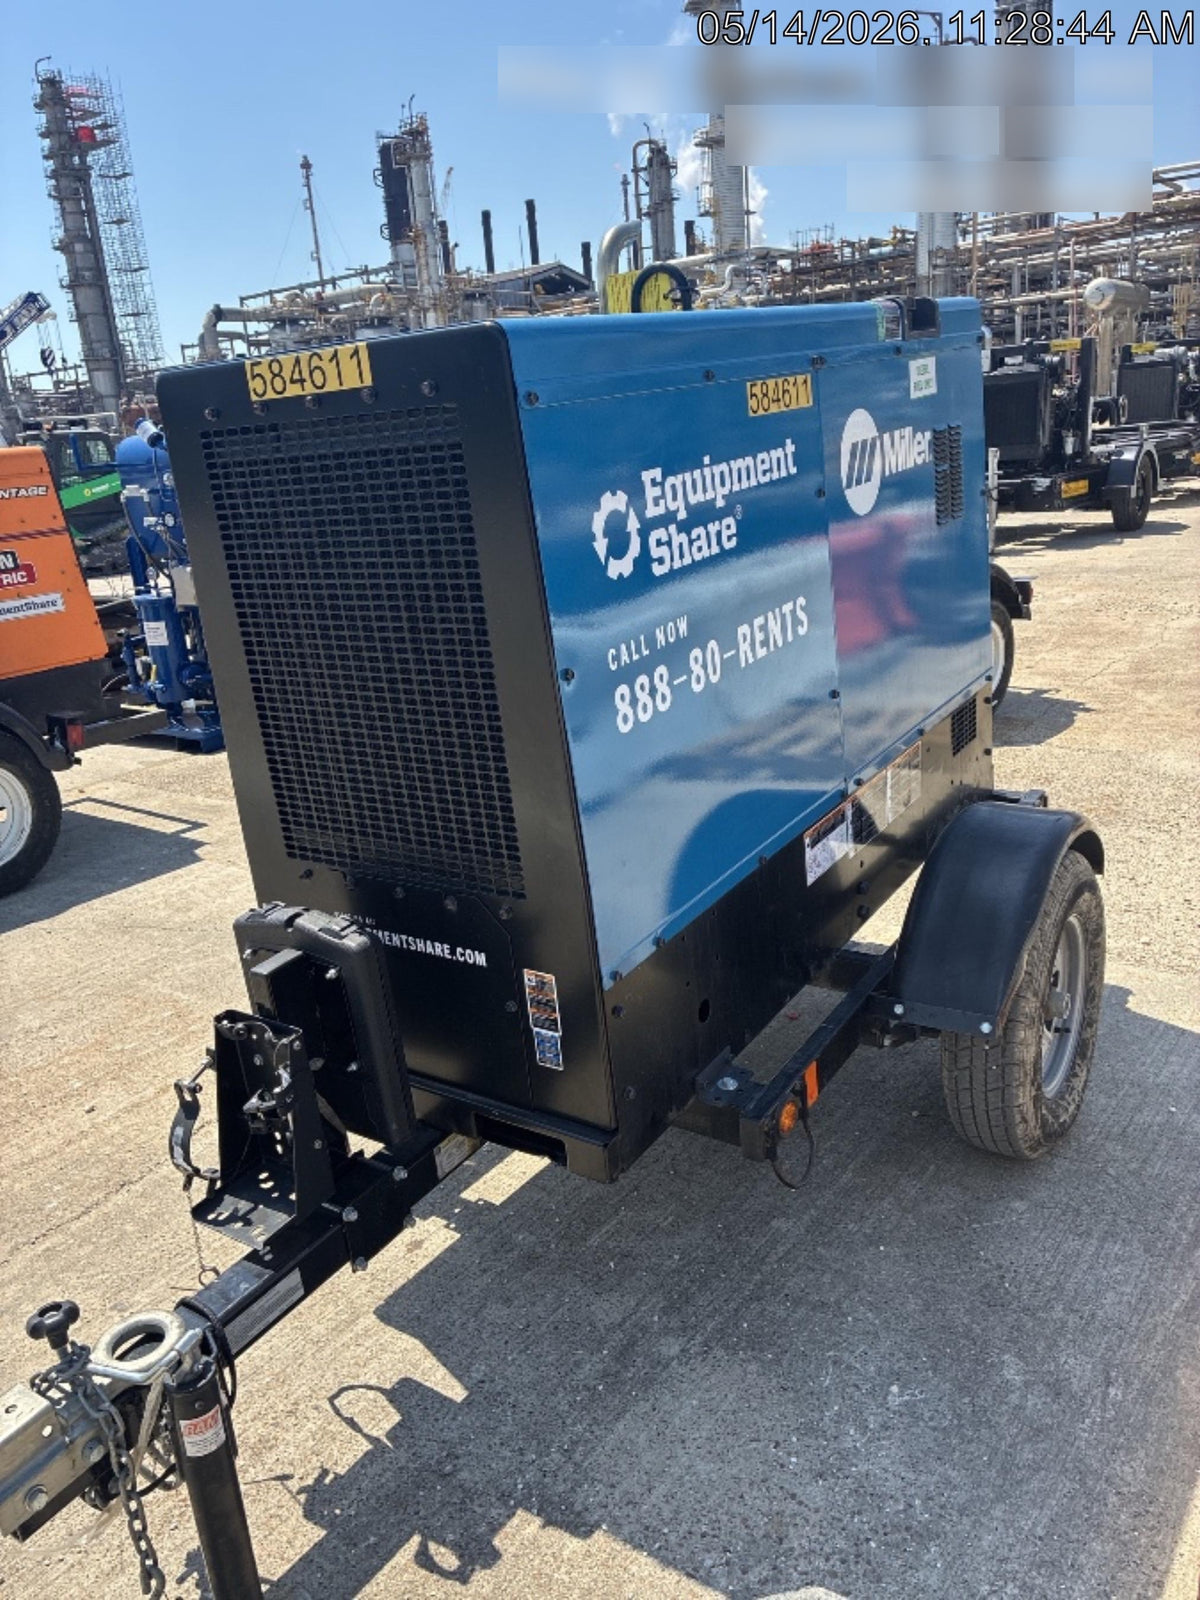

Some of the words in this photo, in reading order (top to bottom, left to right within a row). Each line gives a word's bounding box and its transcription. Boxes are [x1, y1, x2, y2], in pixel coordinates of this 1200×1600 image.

[249, 344, 364, 398] 584611
[749, 375, 811, 414] 584611
[882, 426, 931, 477] Miller
[641, 438, 797, 521] Equipment
[0, 571, 28, 586] RIC
[607, 634, 650, 671] CALL
[655, 614, 688, 649] NOW
[614, 596, 808, 733] 888-80-RENTS
